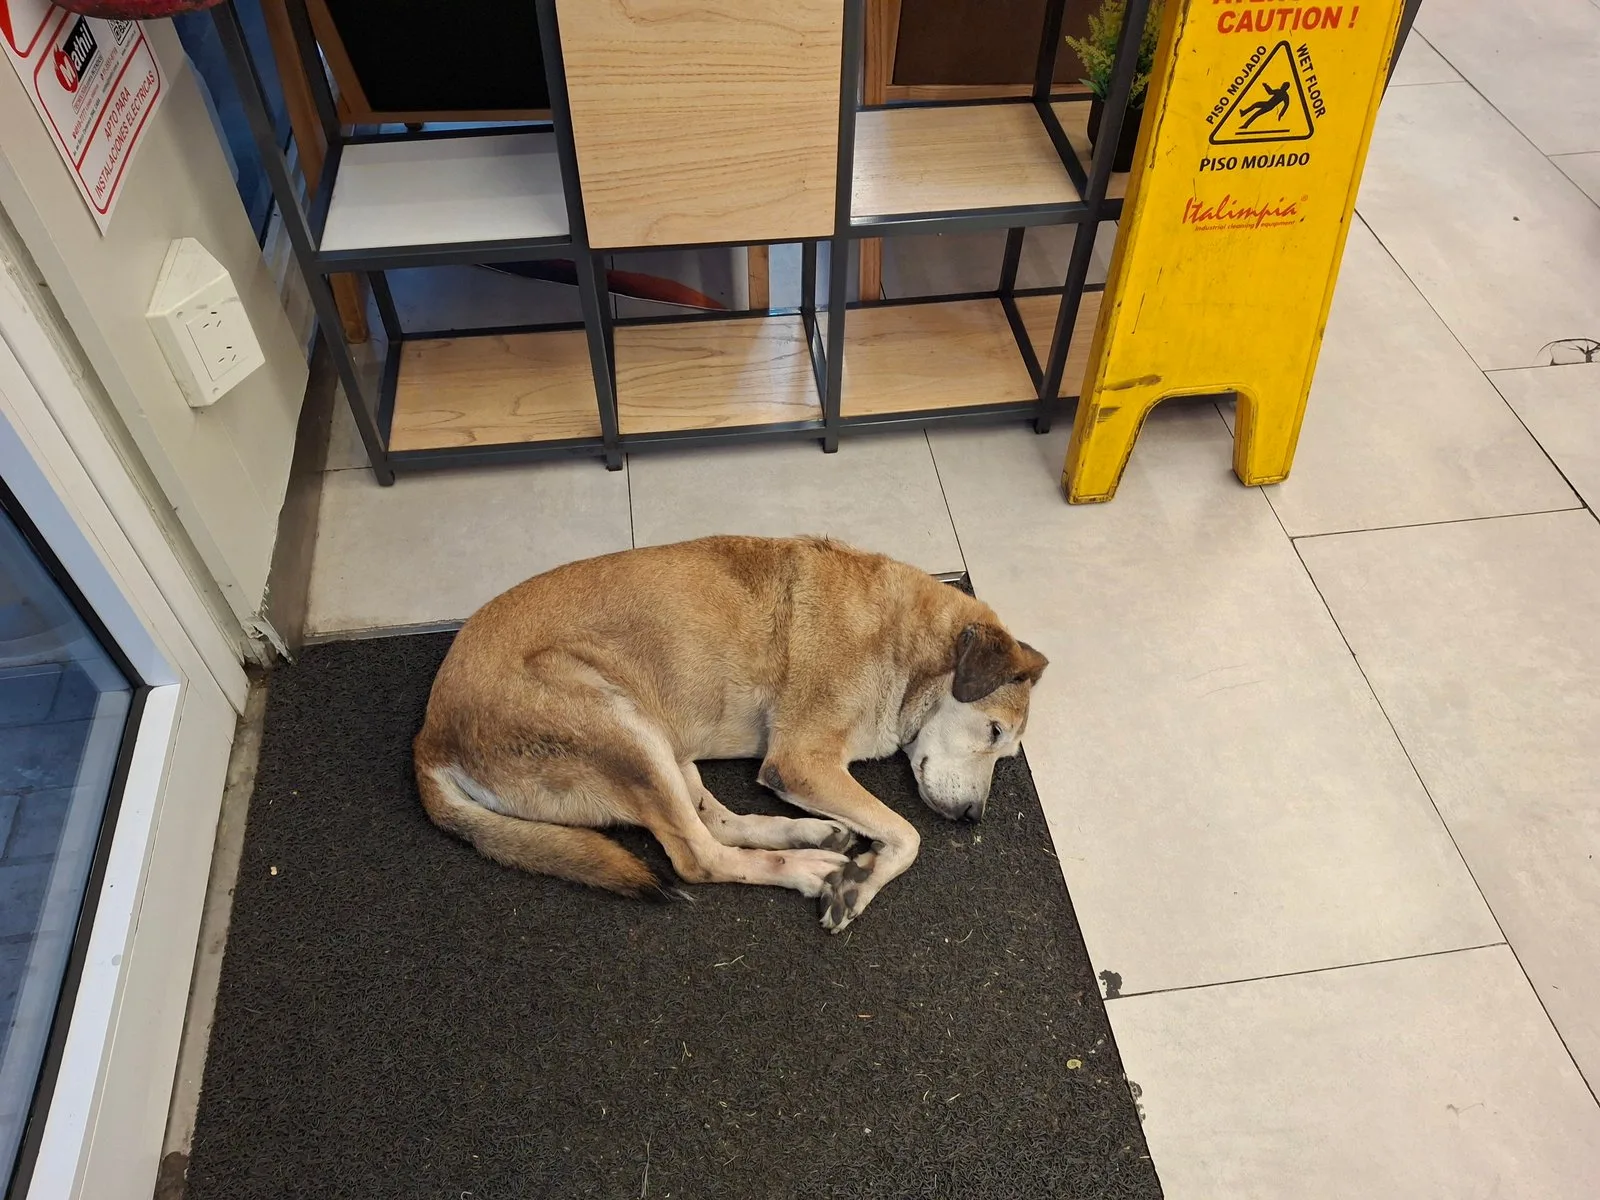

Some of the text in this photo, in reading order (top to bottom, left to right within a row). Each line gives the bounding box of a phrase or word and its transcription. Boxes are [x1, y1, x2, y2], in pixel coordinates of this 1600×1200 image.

[1218, 6, 1359, 34] CAUTION !
[59, 23, 94, 88] Mathil
[1297, 43, 1326, 118] WET FLOOR
[1206, 46, 1266, 124] PISO MOJADO
[95, 121, 129, 199] INSTALACIONES
[126, 70, 155, 127] ELECTRICAS
[104, 110, 119, 141] APTO
[115, 86, 131, 116] PARA
[1199, 152, 1310, 171] PISO MOJADO
[1182, 194, 1297, 229] Italimpia
[1261, 220, 1295, 228] equipment
